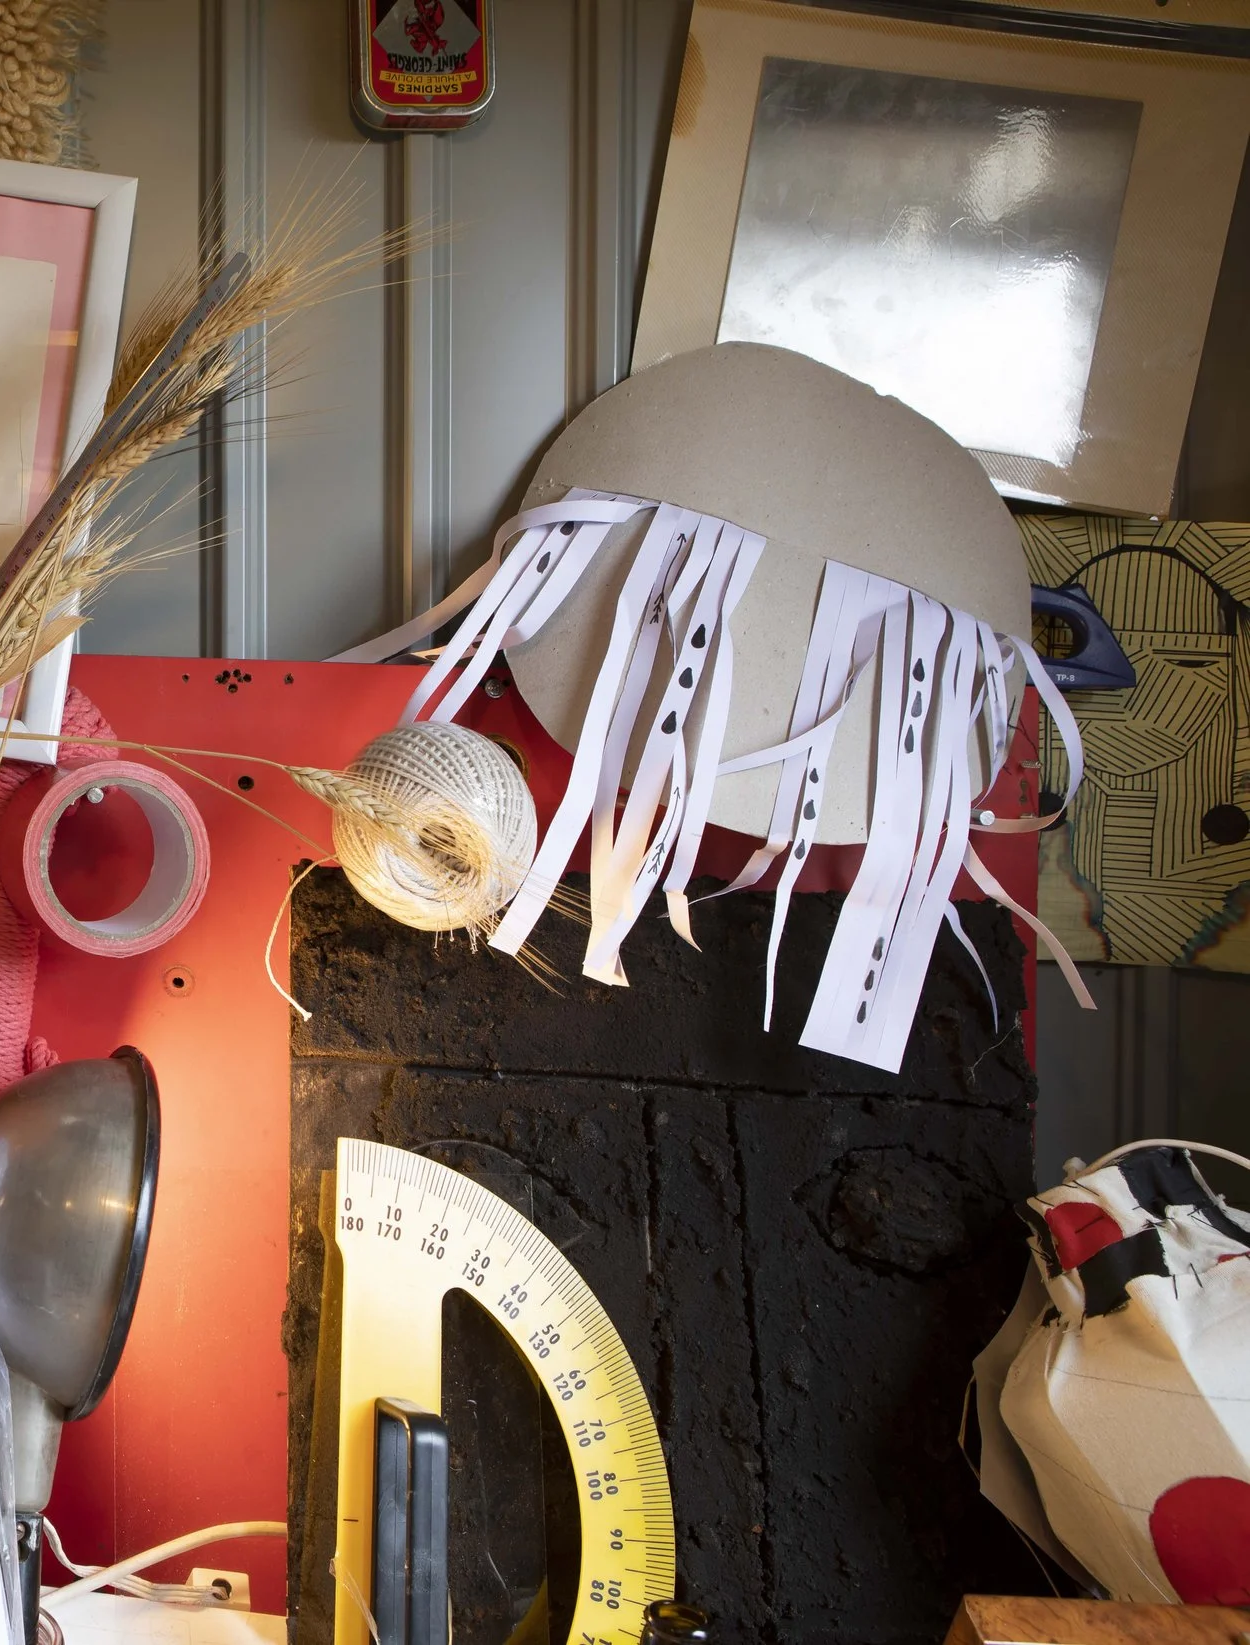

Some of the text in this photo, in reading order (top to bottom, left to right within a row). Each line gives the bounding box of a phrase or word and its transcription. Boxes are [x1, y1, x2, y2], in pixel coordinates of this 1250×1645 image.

[386, 72, 472, 83] A L'HUILE D'OLIVE
[398, 84, 458, 93] SARDINES
[11, 564, 20, 575] 34
[22, 547, 32, 559] 35
[35, 531, 45, 541] 36
[46, 513, 56, 525] 37
[58, 497, 68, 508] 38
[170, 350, 178, 361] 47
[206, 300, 216, 315] 50
[1055, 673, 1076, 682] TP-8
[340, 1215, 605, 1645] 180 170 160 150 140 130 120 110 100 80 7
[344, 1197, 623, 1609] 0 10 20 30 40 50 60 70 80 90 100
